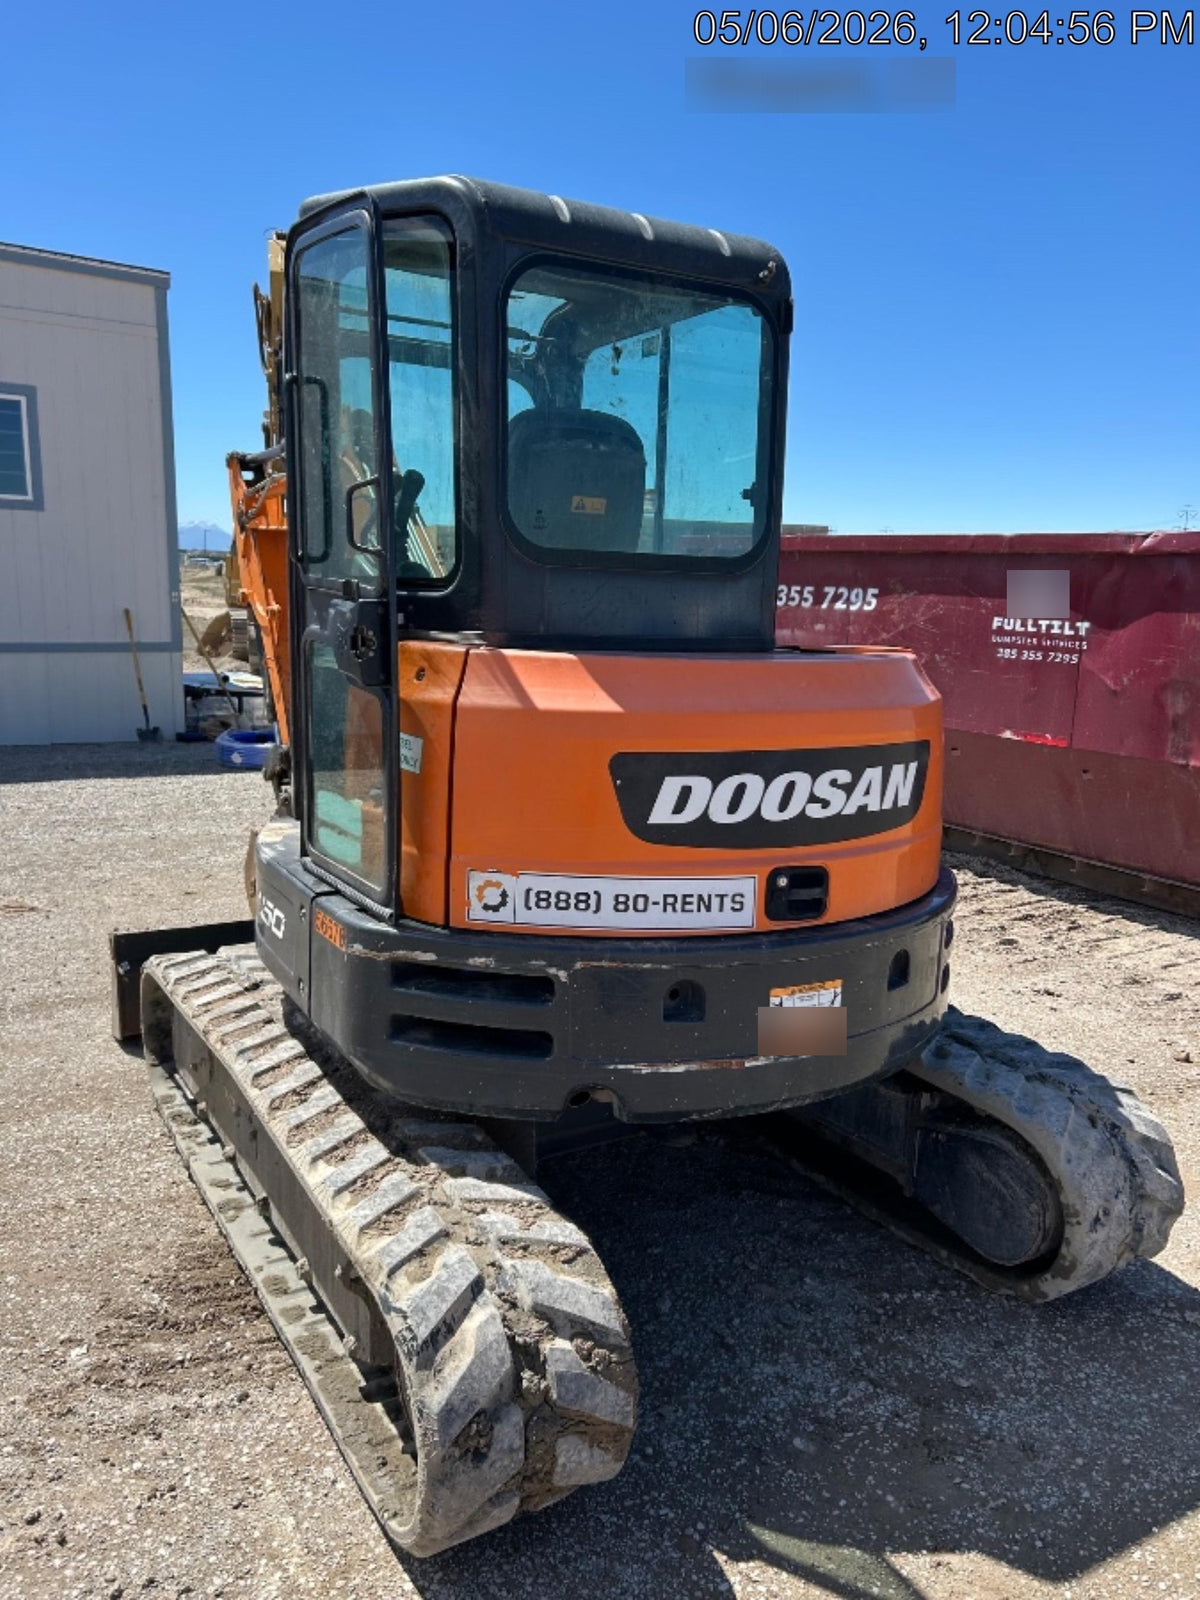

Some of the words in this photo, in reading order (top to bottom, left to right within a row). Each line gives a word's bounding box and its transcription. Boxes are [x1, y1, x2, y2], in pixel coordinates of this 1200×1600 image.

[776, 584, 815, 609] 355
[820, 586, 880, 611] 7295
[991, 616, 1091, 636] FULLTILT
[1020, 650, 1043, 661] 355
[1046, 652, 1080, 664] 7295
[647, 761, 918, 824] DOOSAN
[523, 887, 602, 914] (888)
[612, 893, 746, 913] 80-RENTS
